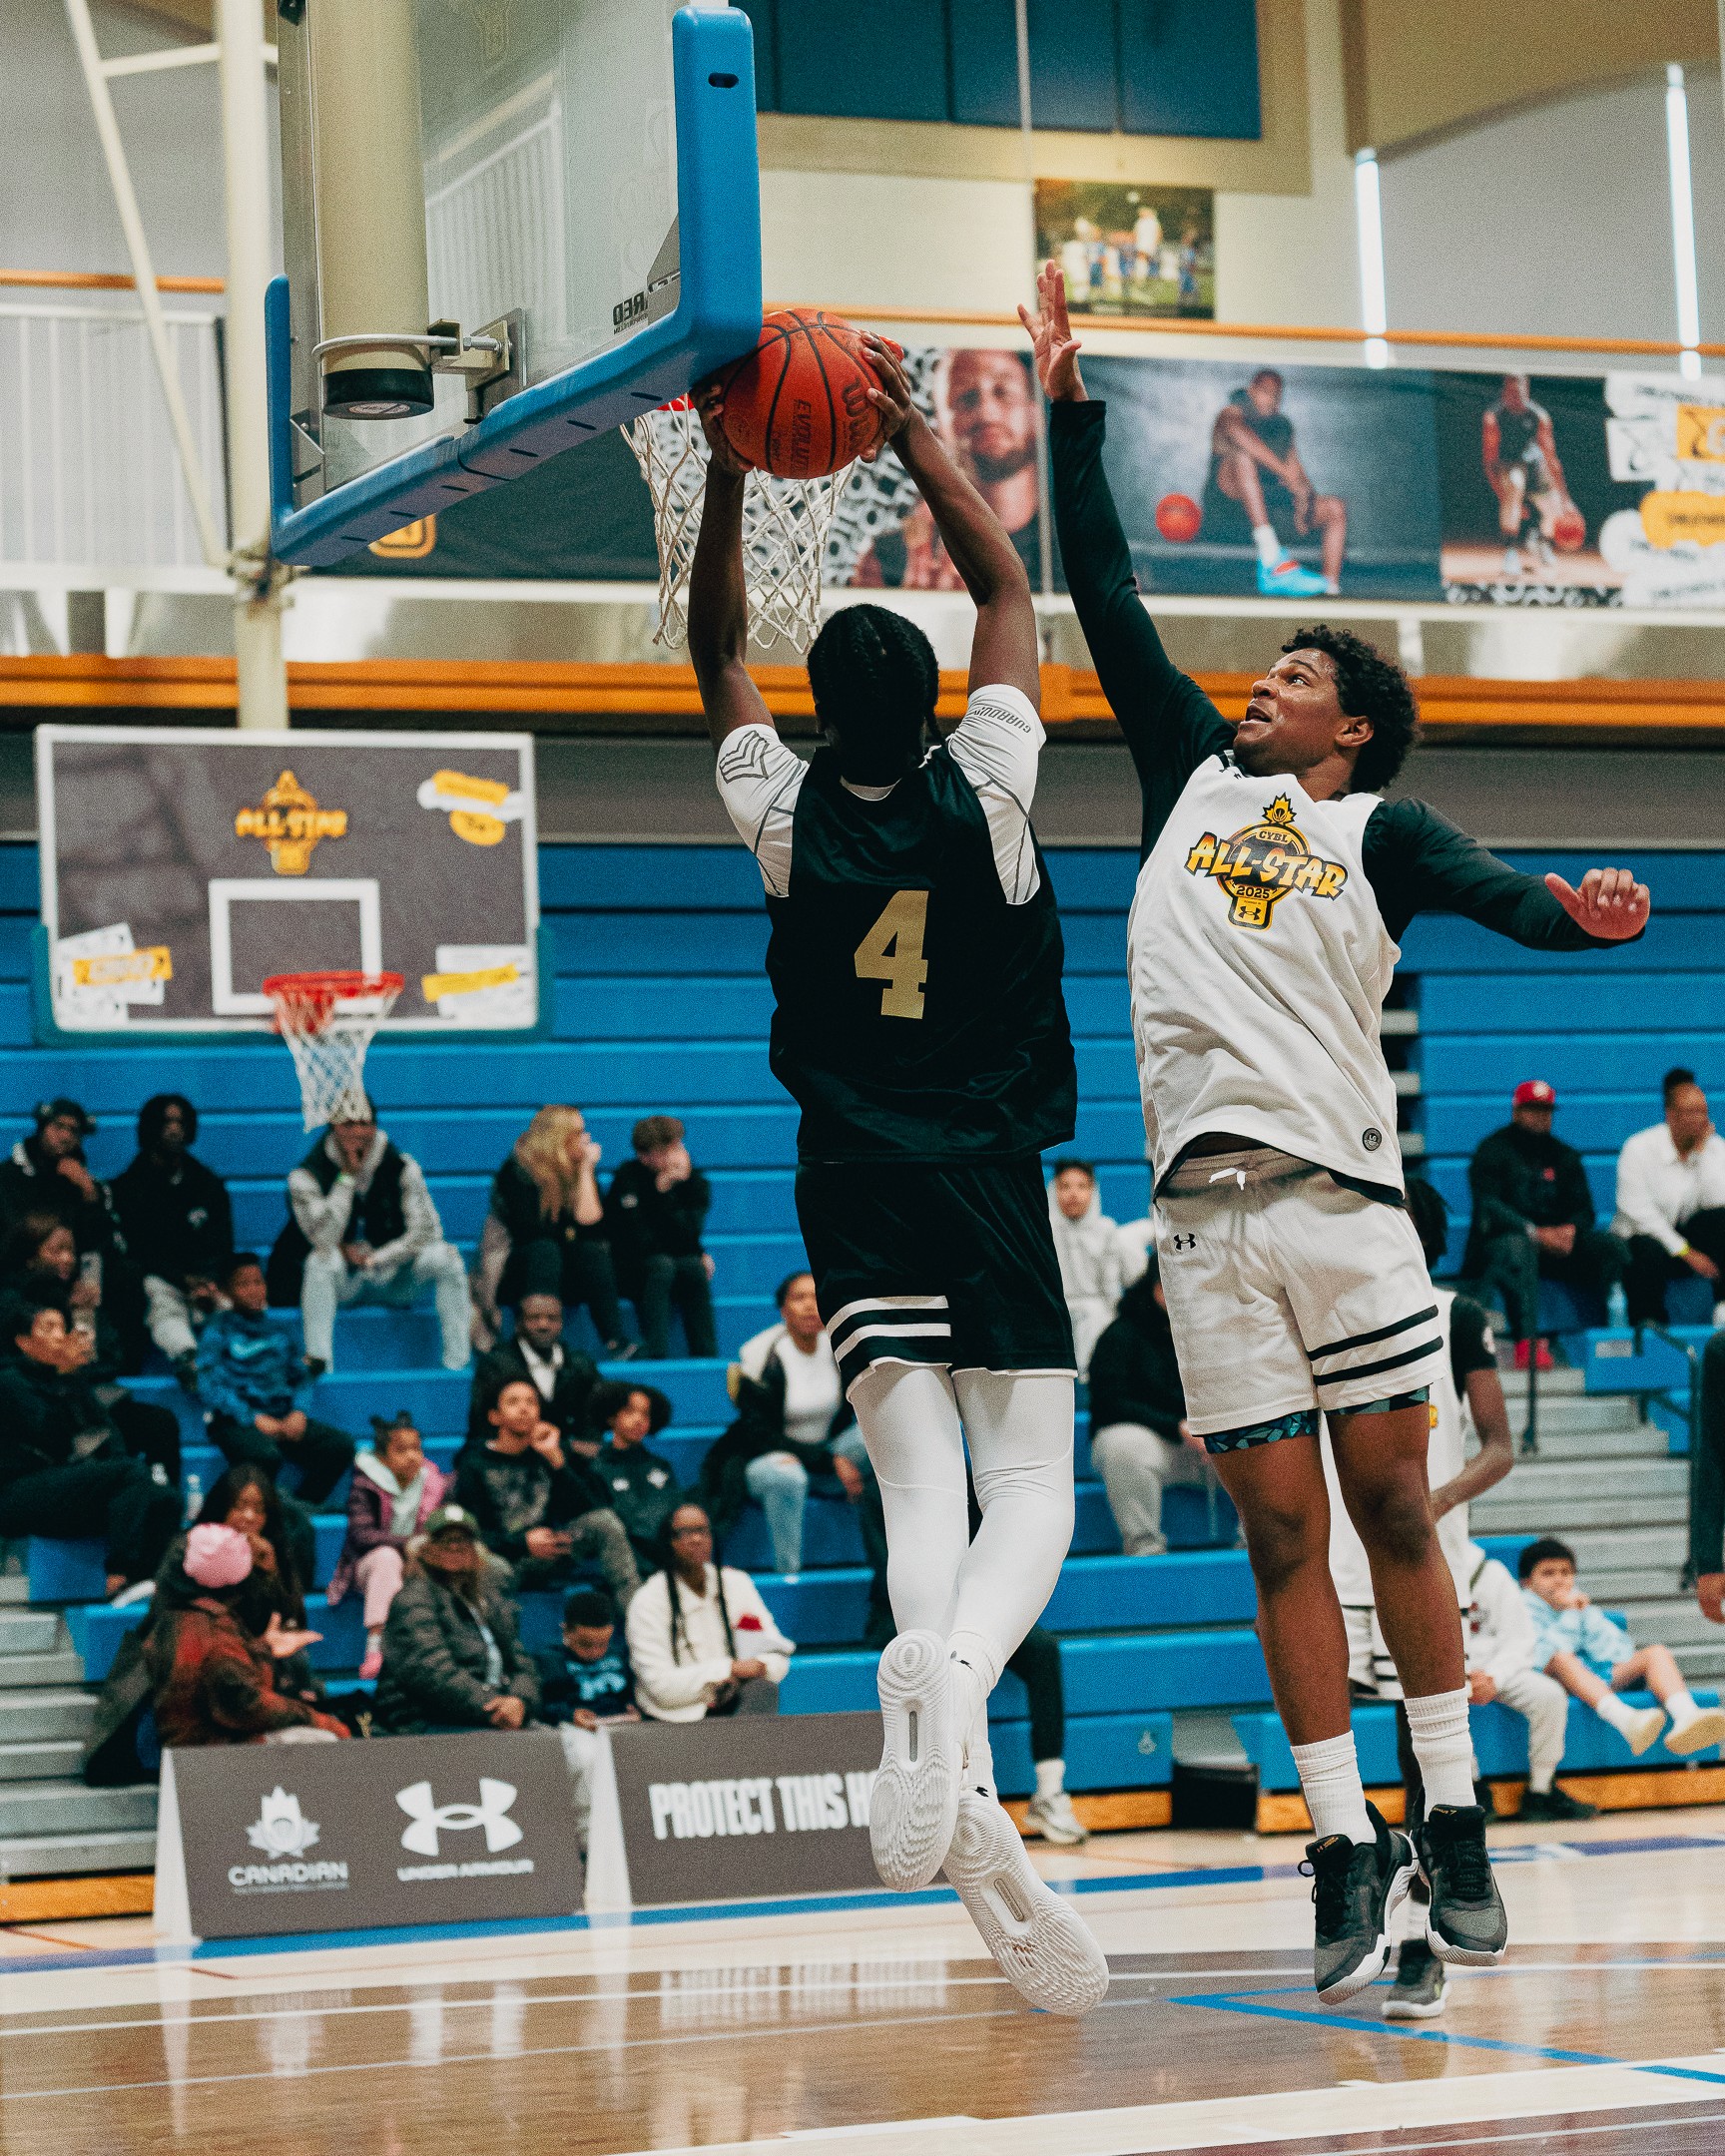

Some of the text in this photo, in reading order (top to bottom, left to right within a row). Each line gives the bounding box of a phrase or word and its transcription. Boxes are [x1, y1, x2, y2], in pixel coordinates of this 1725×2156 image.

[1258, 830, 1290, 843] CYBL
[1185, 831, 1348, 900] ALL-STAR
[1236, 885, 1270, 899] 2025
[854, 889, 929, 1020] 4
[649, 1777, 776, 1841] PROTECT
[775, 1772, 850, 1833] THIS
[228, 1861, 349, 1887] CANADIAN
